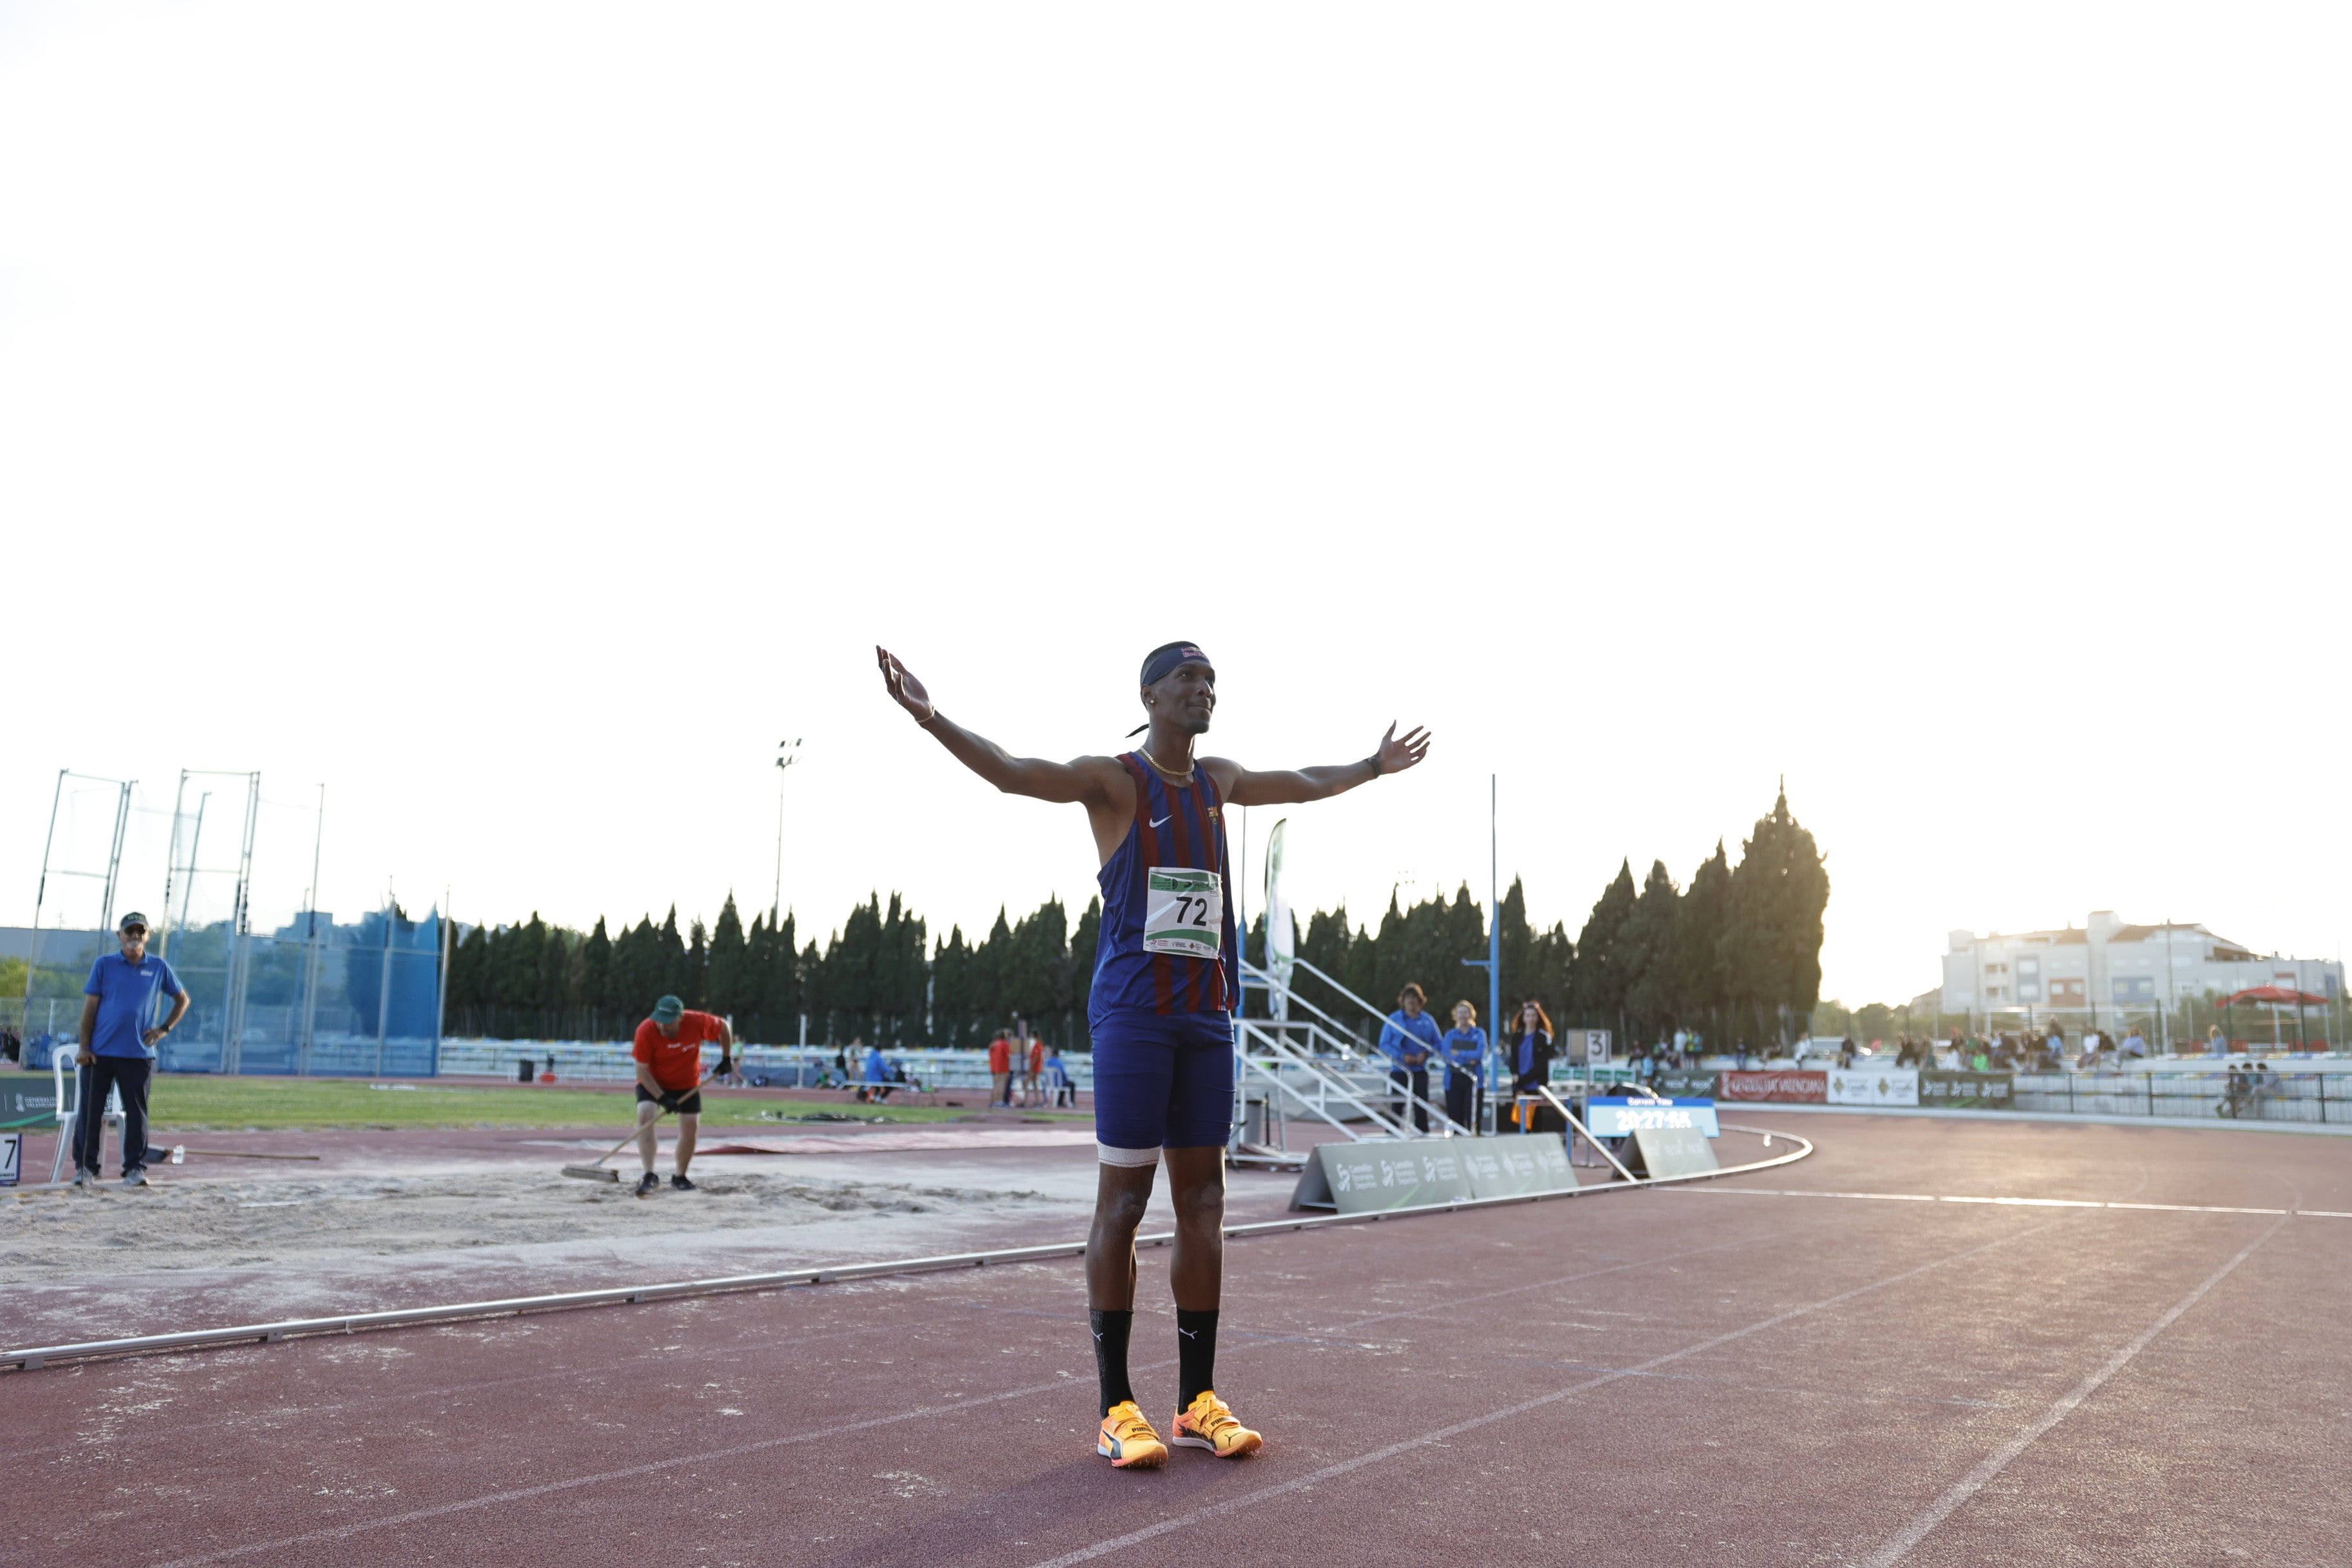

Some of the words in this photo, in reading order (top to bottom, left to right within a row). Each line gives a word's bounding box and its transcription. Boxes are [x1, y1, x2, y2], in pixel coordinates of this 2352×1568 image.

[1176, 896, 1208, 926] 72
[1591, 1034, 1602, 1056] 3
[5, 1139, 17, 1169] 7
